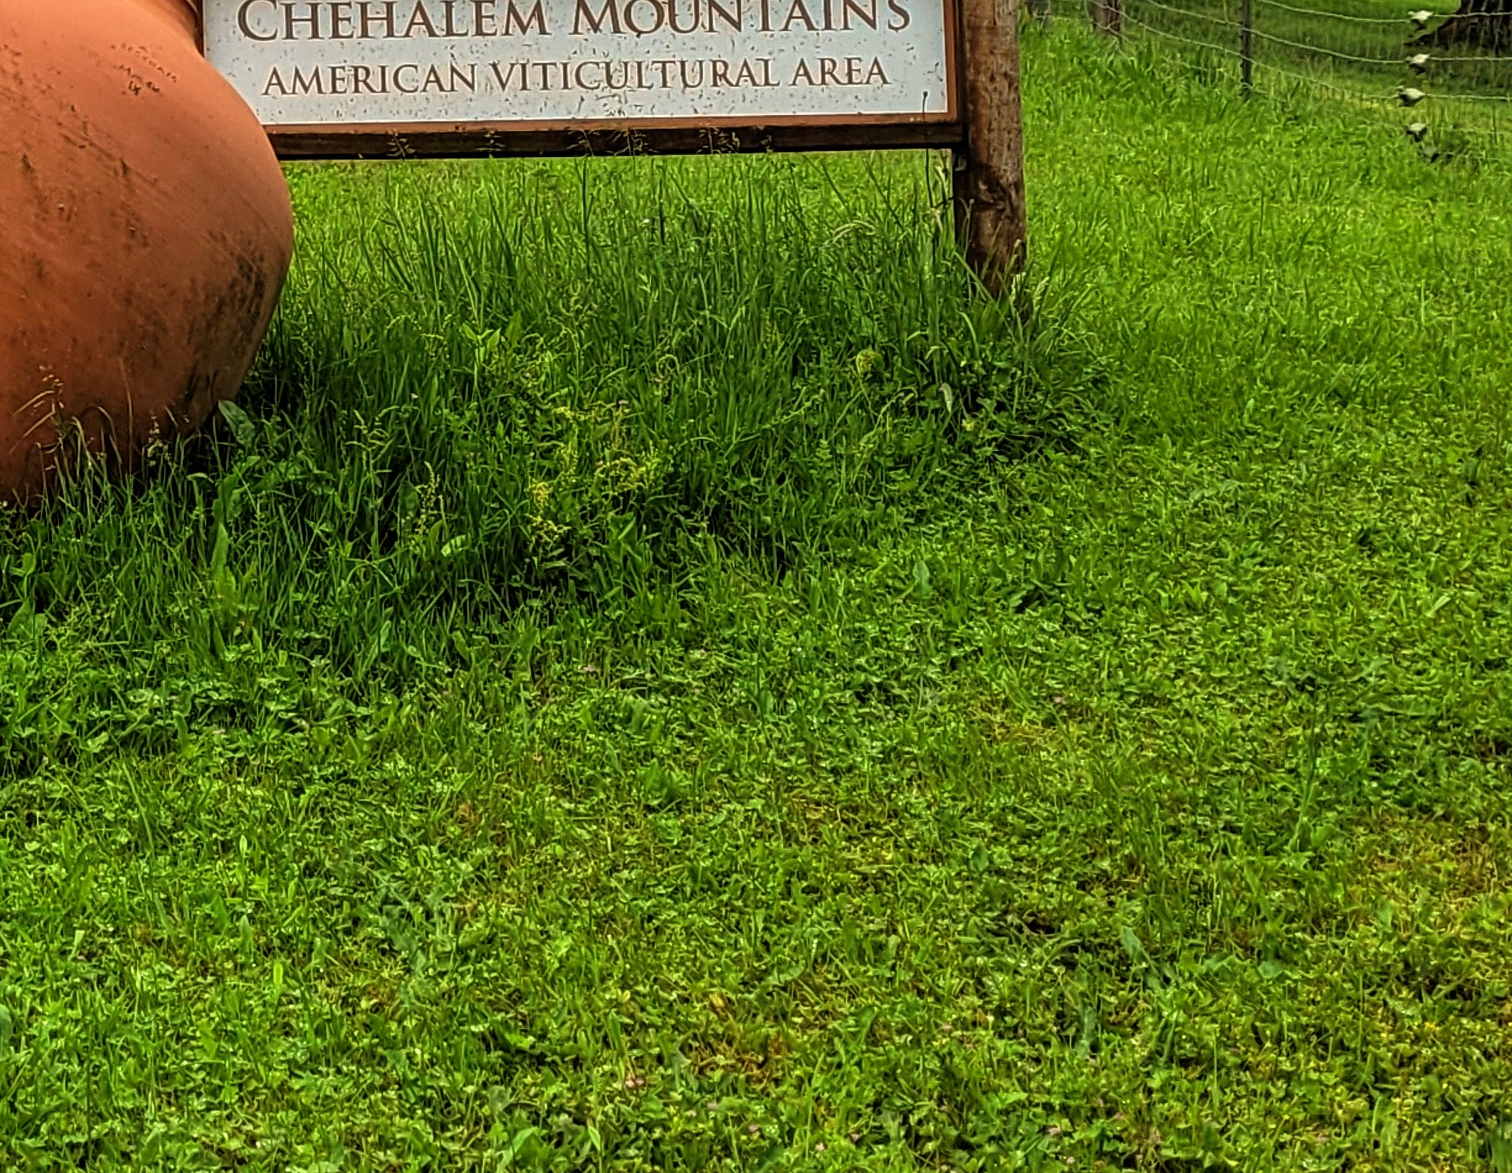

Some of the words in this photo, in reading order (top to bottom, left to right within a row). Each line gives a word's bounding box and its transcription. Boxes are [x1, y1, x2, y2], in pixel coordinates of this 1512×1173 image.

[261, 62, 476, 96] AMERICAN
[489, 58, 778, 91] VITICULTURAL
[789, 55, 889, 88] AREA
